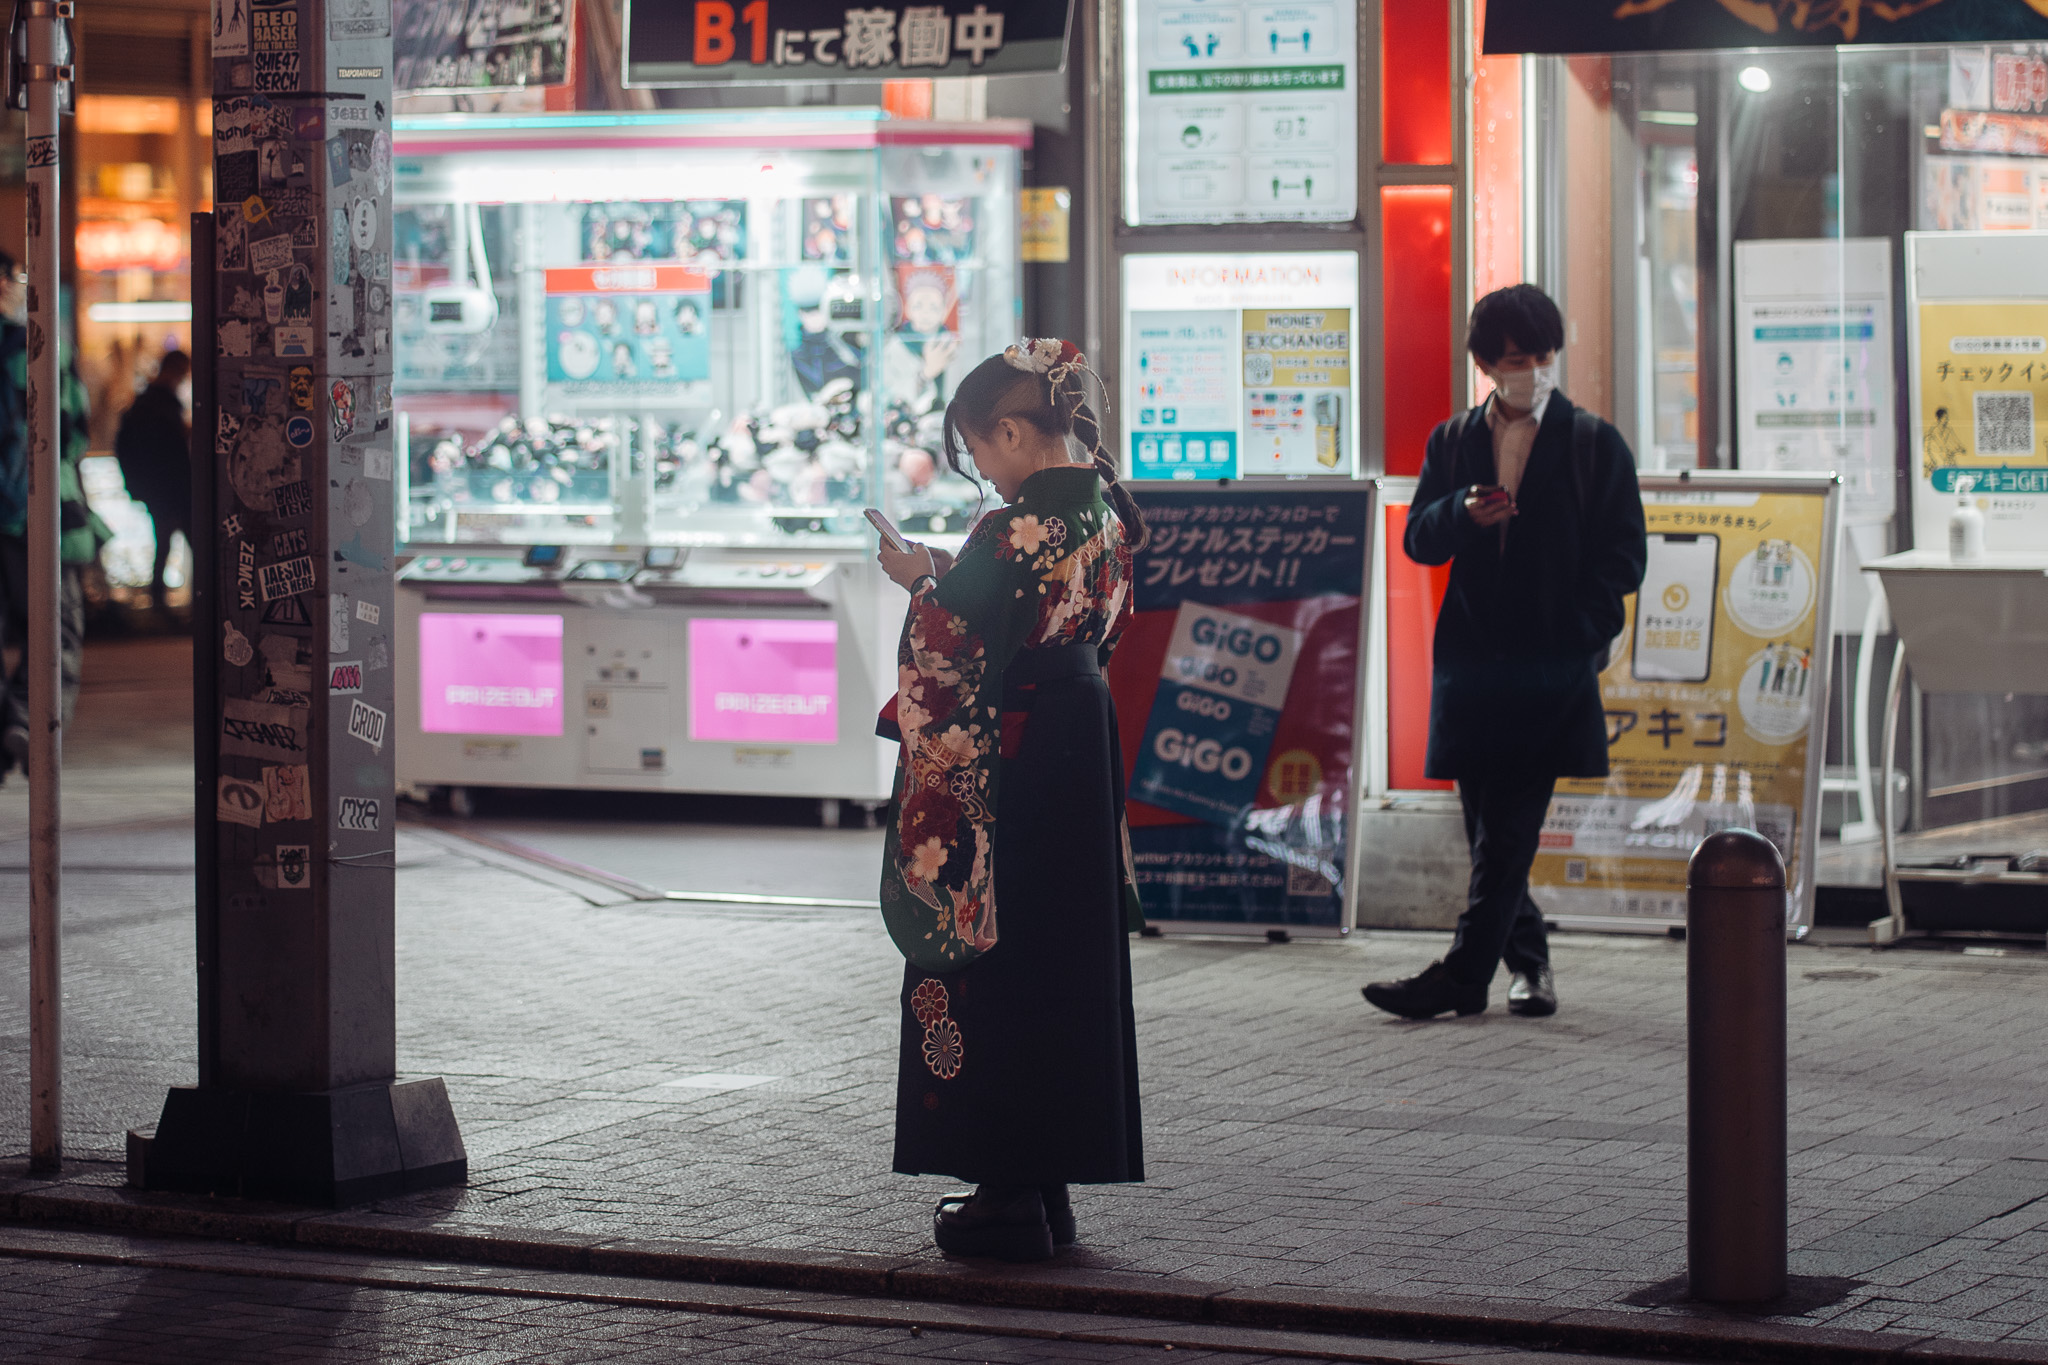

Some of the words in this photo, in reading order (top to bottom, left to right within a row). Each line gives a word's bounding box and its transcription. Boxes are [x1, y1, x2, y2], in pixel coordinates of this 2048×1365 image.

[692, 0, 1005, 66] B1にて稼働中
[255, 71, 299, 91] SERCH
[1167, 266, 1322, 287] INFORMATION
[1267, 314, 1325, 328] MONEY
[1245, 332, 1349, 351] EXCHANGE
[273, 529, 307, 557] CATS
[291, 576, 314, 594] HERE
[1190, 616, 1282, 664] GiGO
[1177, 690, 1232, 721] GiGO
[352, 703, 383, 743] CROD
[1154, 727, 1253, 781] GiGO
